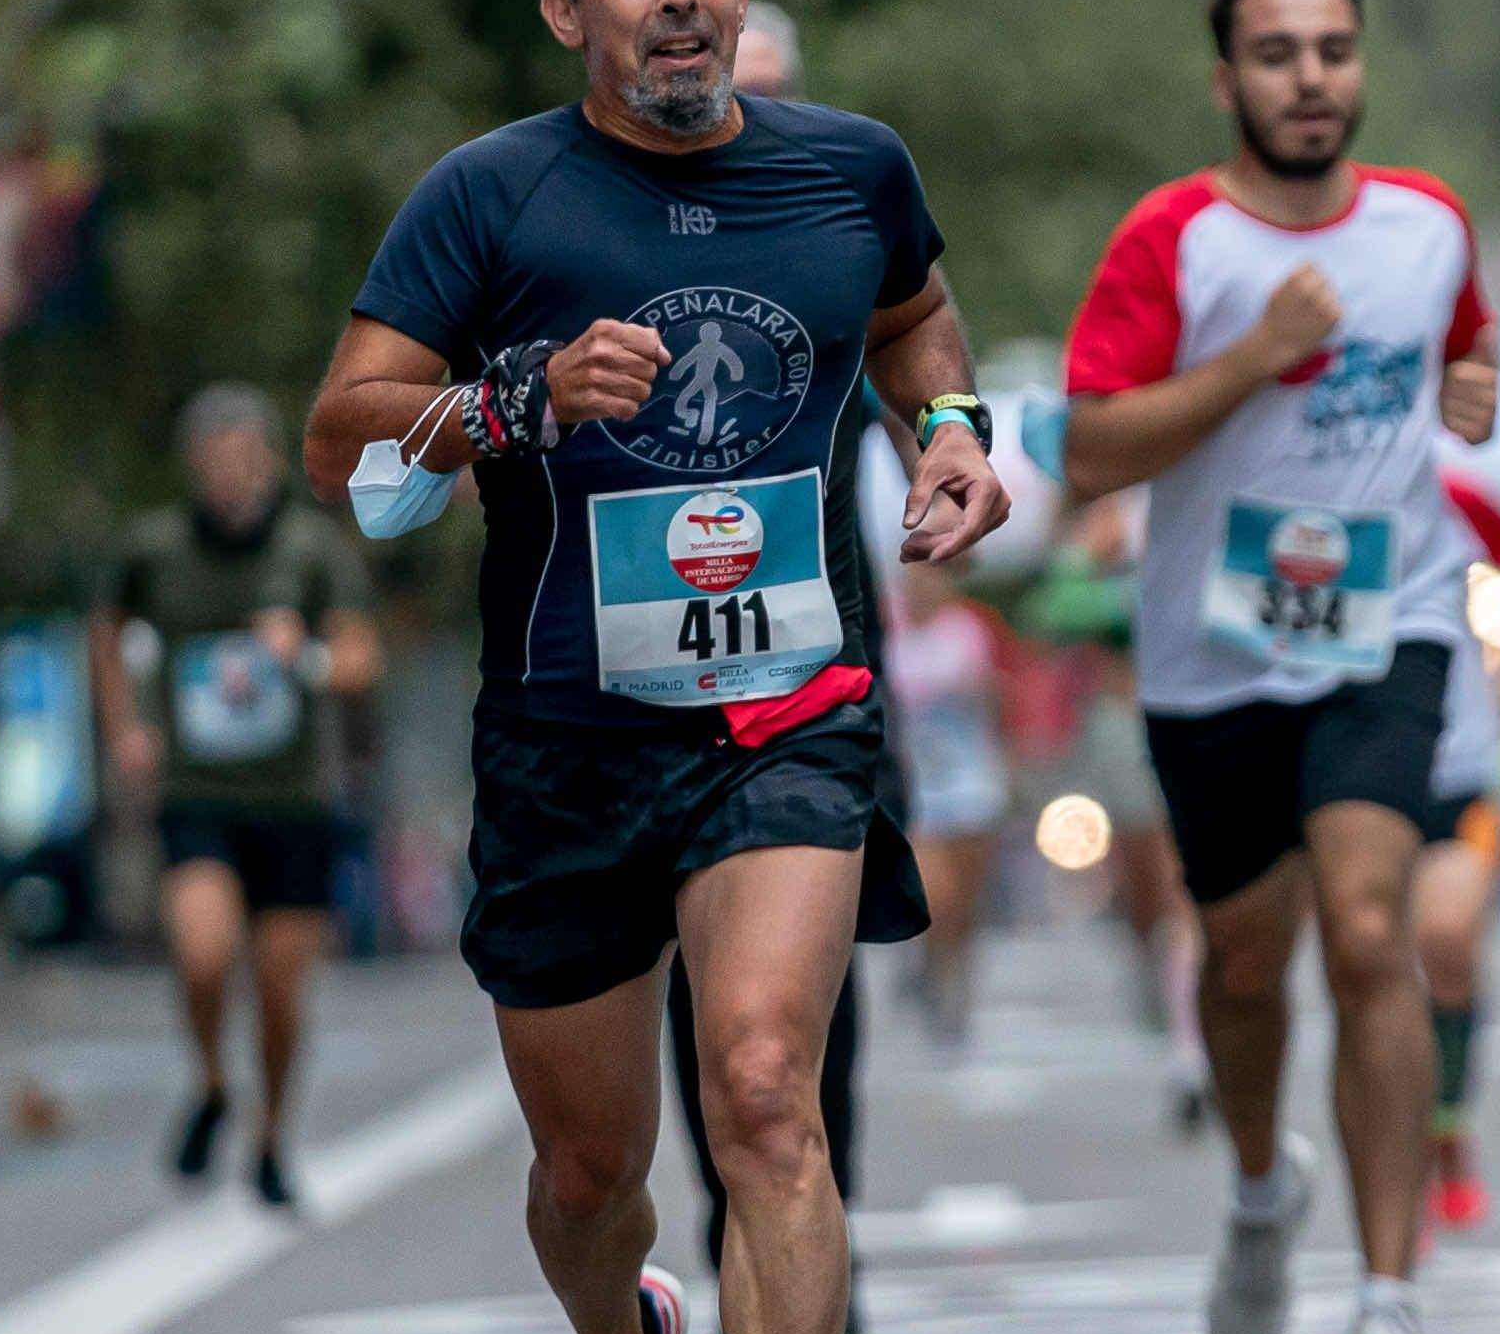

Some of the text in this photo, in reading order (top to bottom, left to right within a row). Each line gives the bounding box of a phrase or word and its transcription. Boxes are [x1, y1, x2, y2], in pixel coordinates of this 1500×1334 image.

[644, 289, 799, 348] PEÑALARA
[628, 425, 772, 468] Finisher
[677, 589, 771, 661] 411
[628, 679, 684, 693] MADRID
